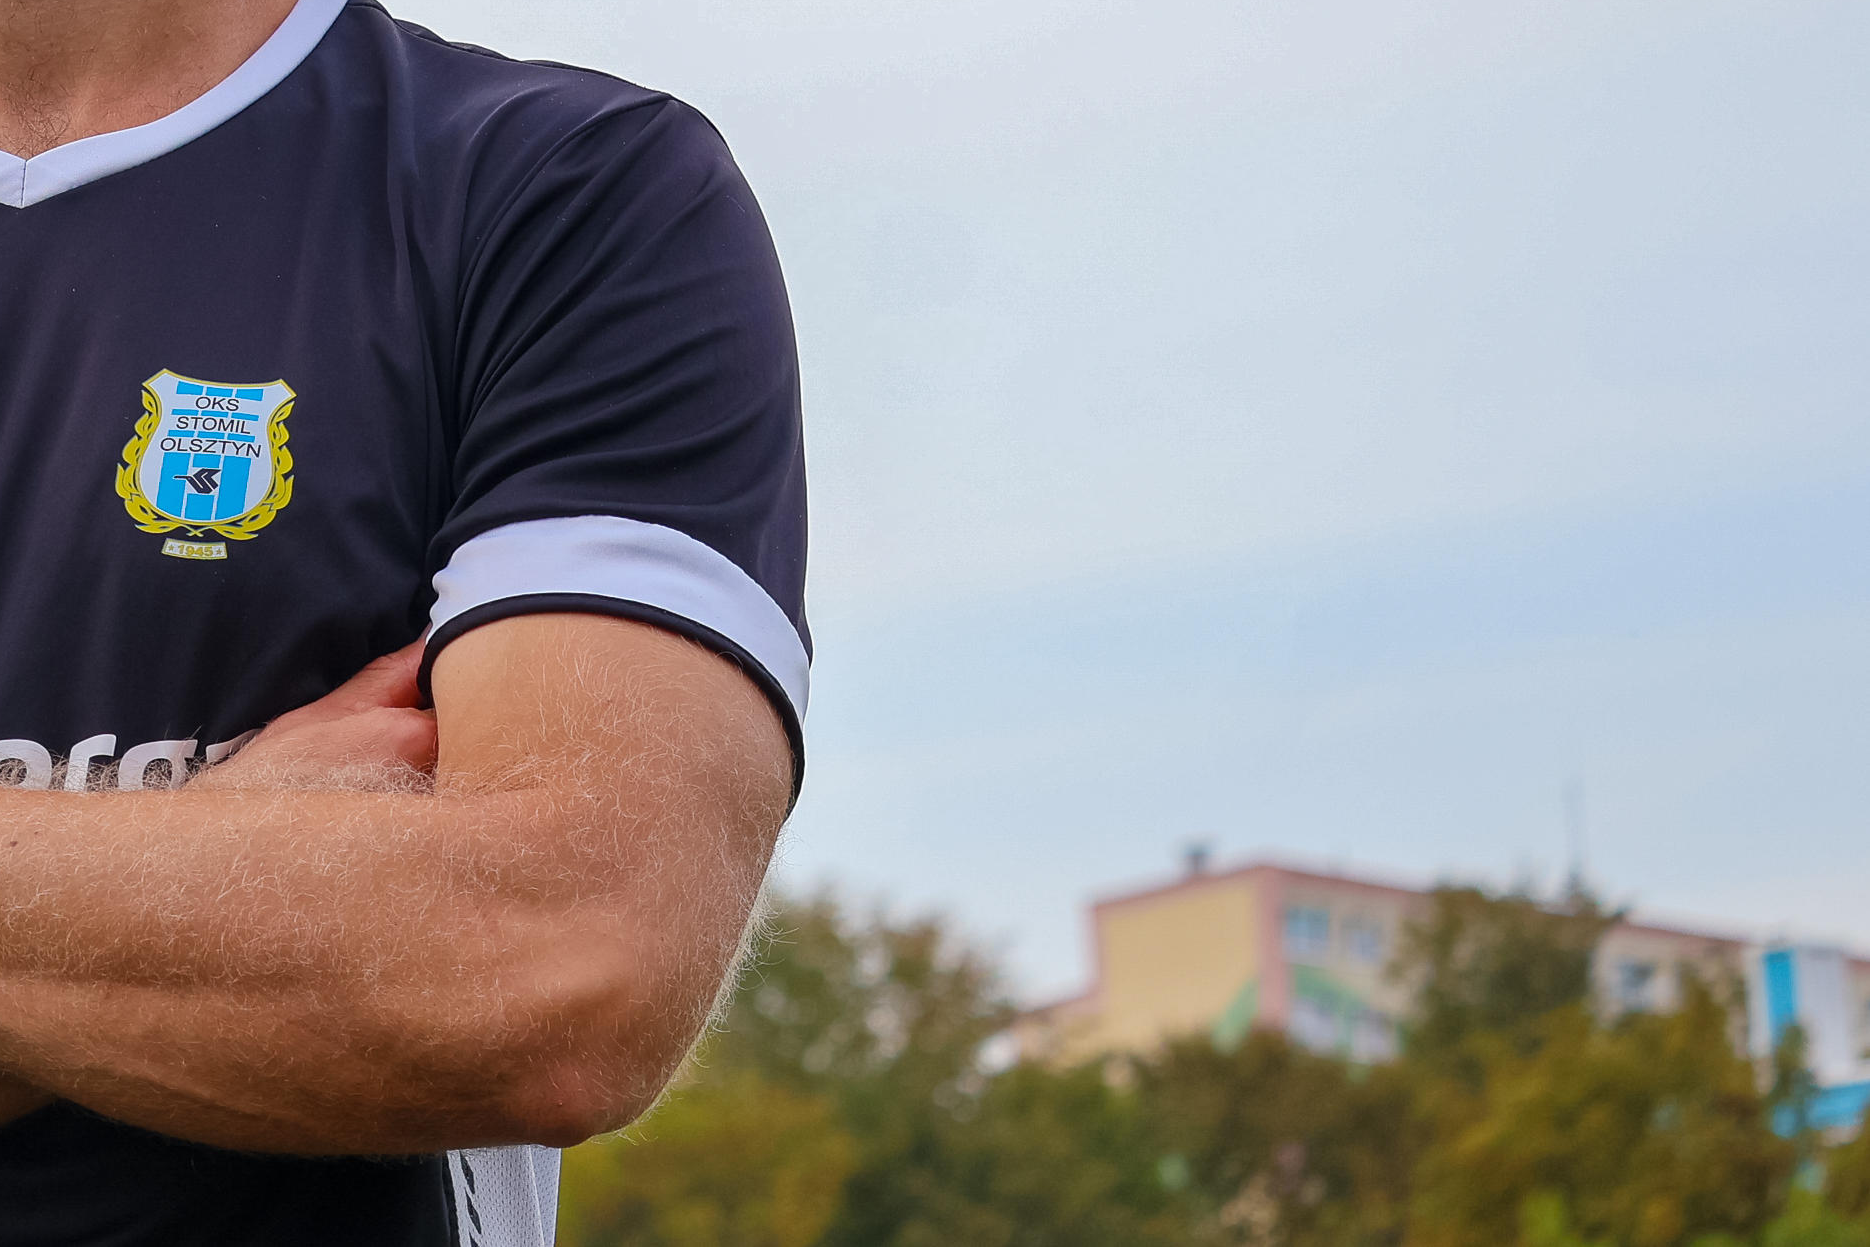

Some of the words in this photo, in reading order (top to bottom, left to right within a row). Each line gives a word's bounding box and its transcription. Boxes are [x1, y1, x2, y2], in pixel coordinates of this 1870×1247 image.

[195, 396, 240, 412] OKS
[176, 416, 251, 435] STOMIL
[160, 438, 262, 458] OLSZTYN
[177, 544, 213, 558] 1945
